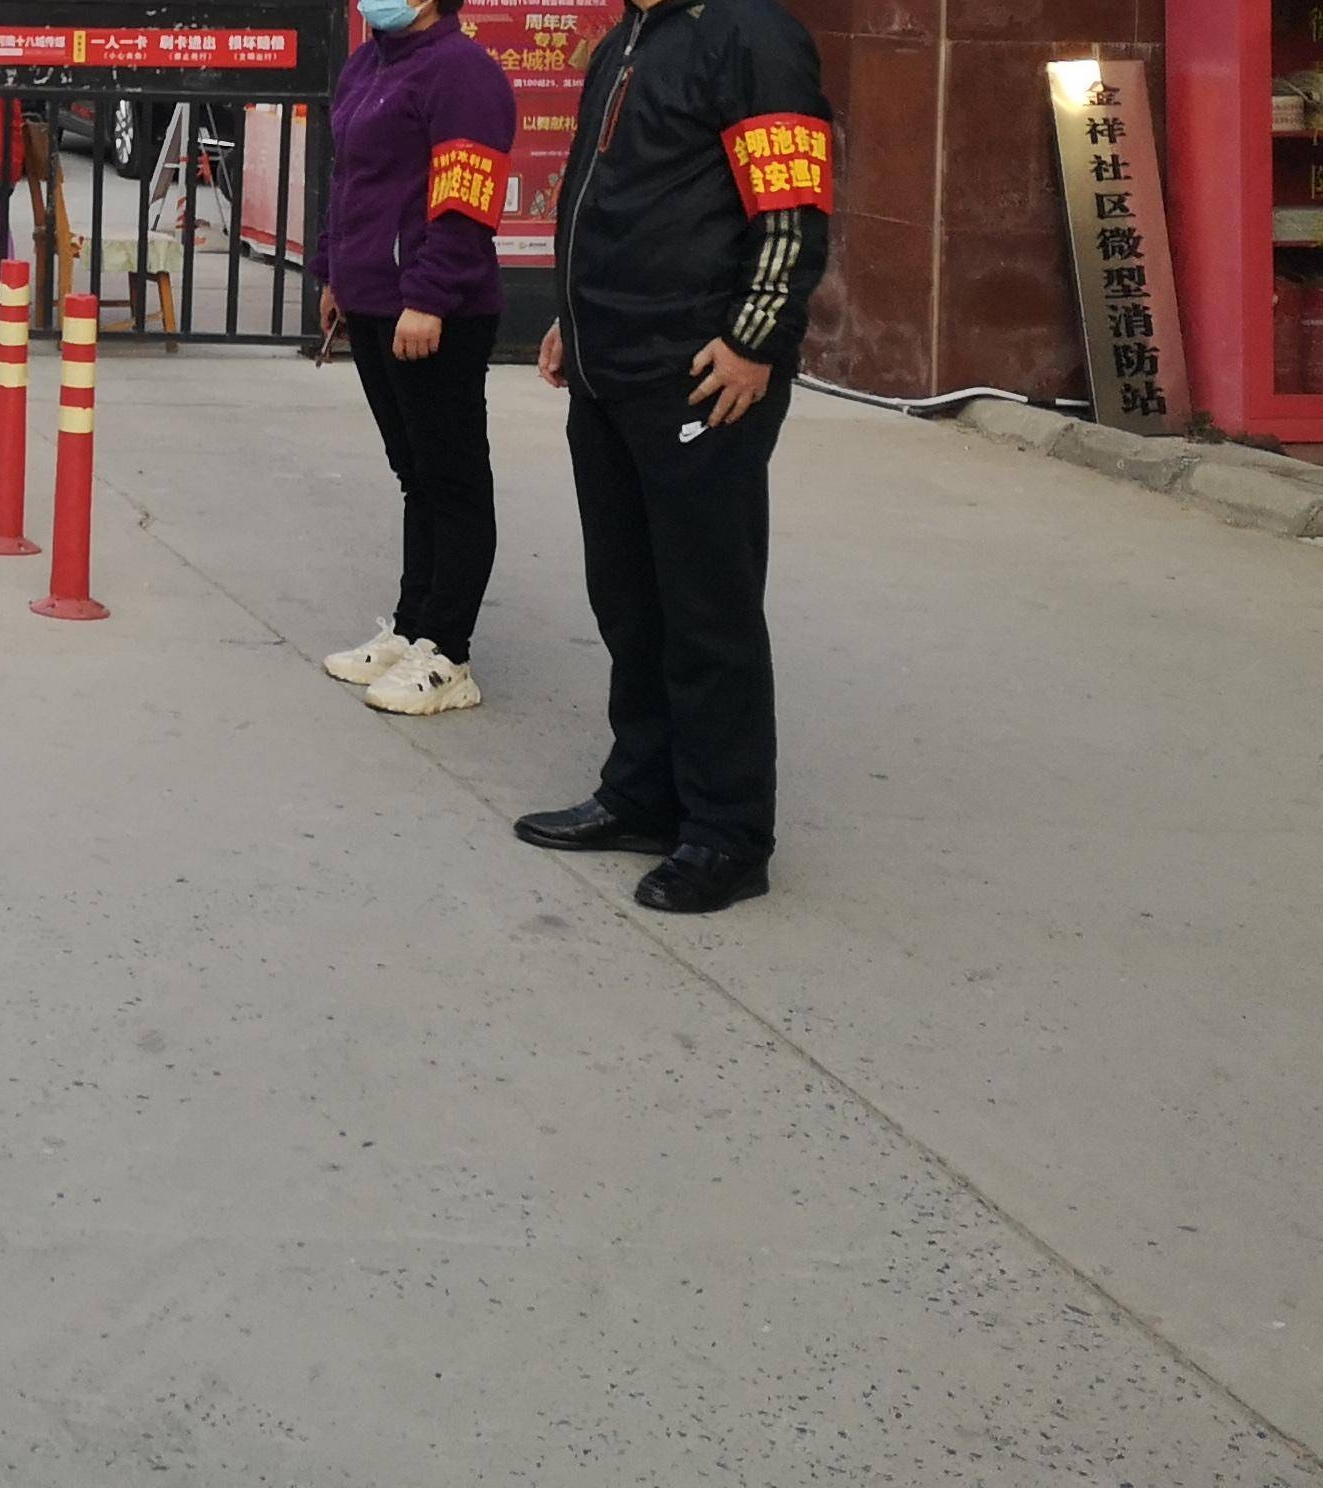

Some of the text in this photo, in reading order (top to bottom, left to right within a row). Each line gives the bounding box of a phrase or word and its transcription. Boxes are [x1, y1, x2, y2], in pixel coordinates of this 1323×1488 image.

[526, 14, 578, 30] 周年庆
[91, 35, 148, 50] 一人一卡
[1082, 79, 1166, 417] 金祥社区微型消防站
